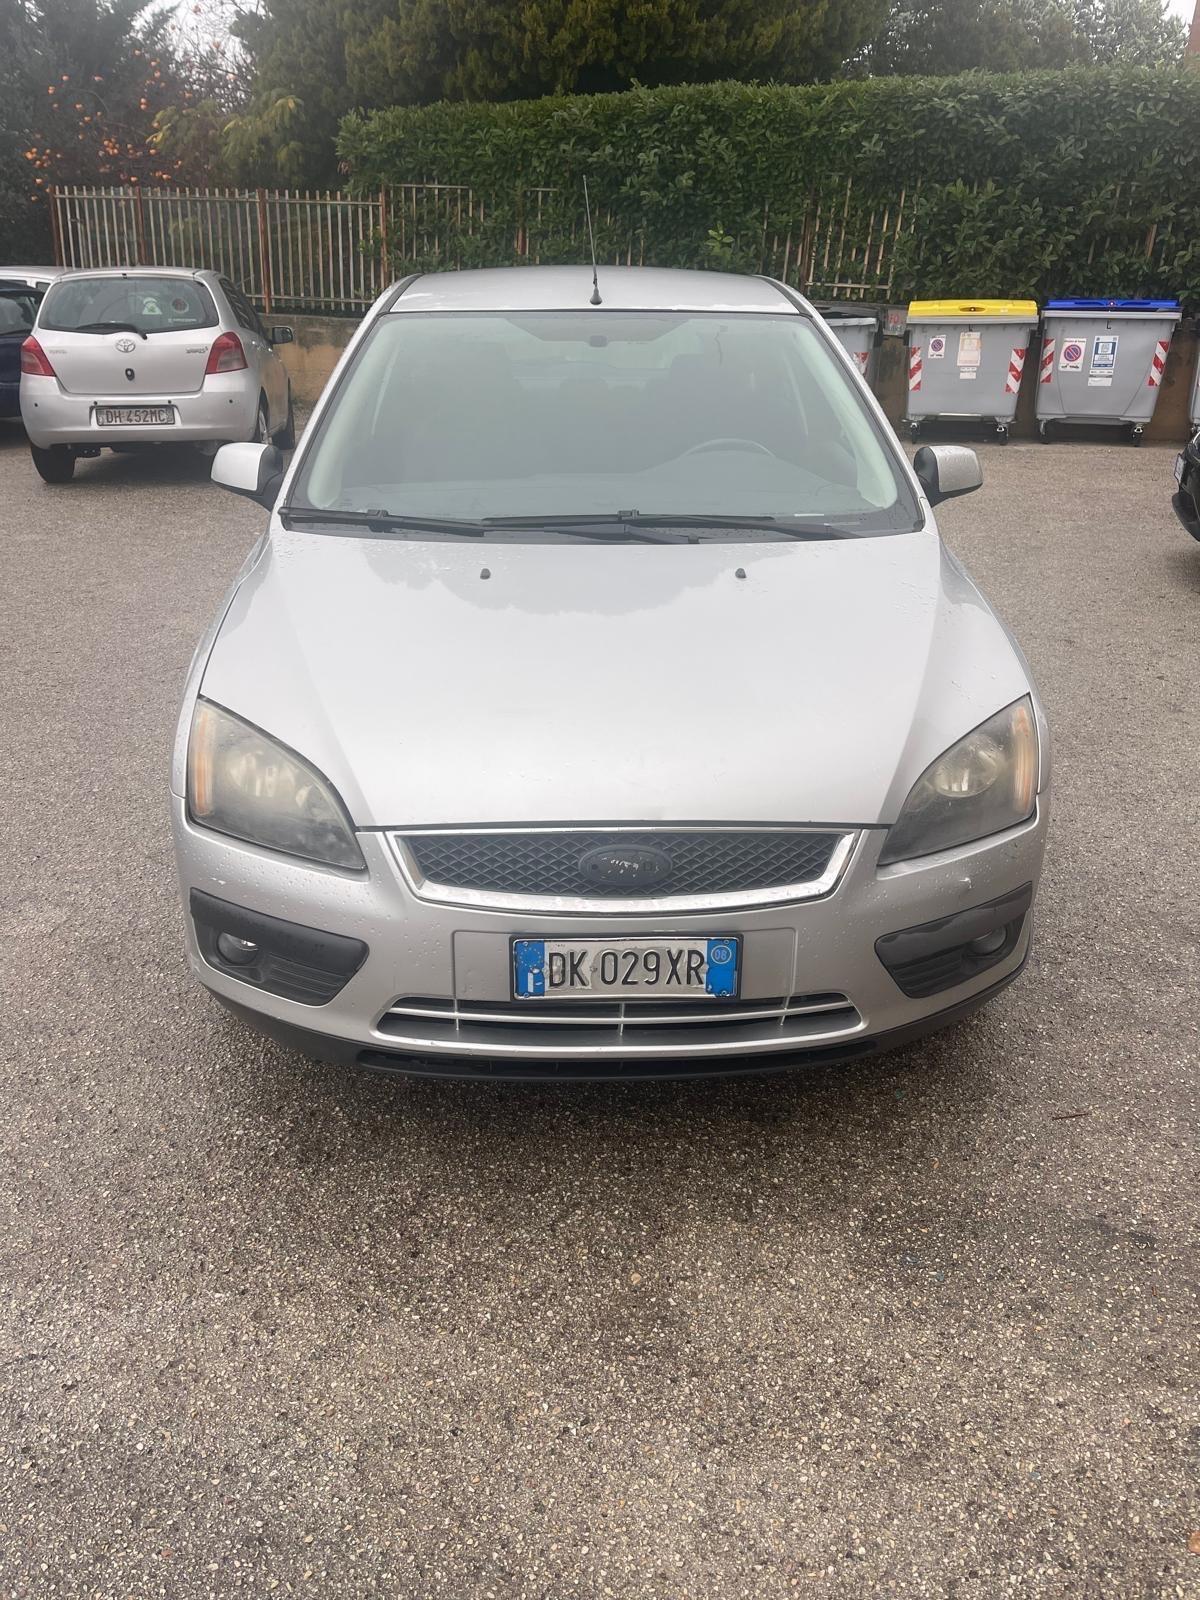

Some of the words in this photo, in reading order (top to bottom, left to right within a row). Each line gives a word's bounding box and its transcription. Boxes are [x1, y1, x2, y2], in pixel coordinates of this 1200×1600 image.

[105, 409, 122, 424] DH
[126, 408, 166, 423] 452MC
[548, 951, 588, 987] DK
[601, 949, 705, 986] 029XR
